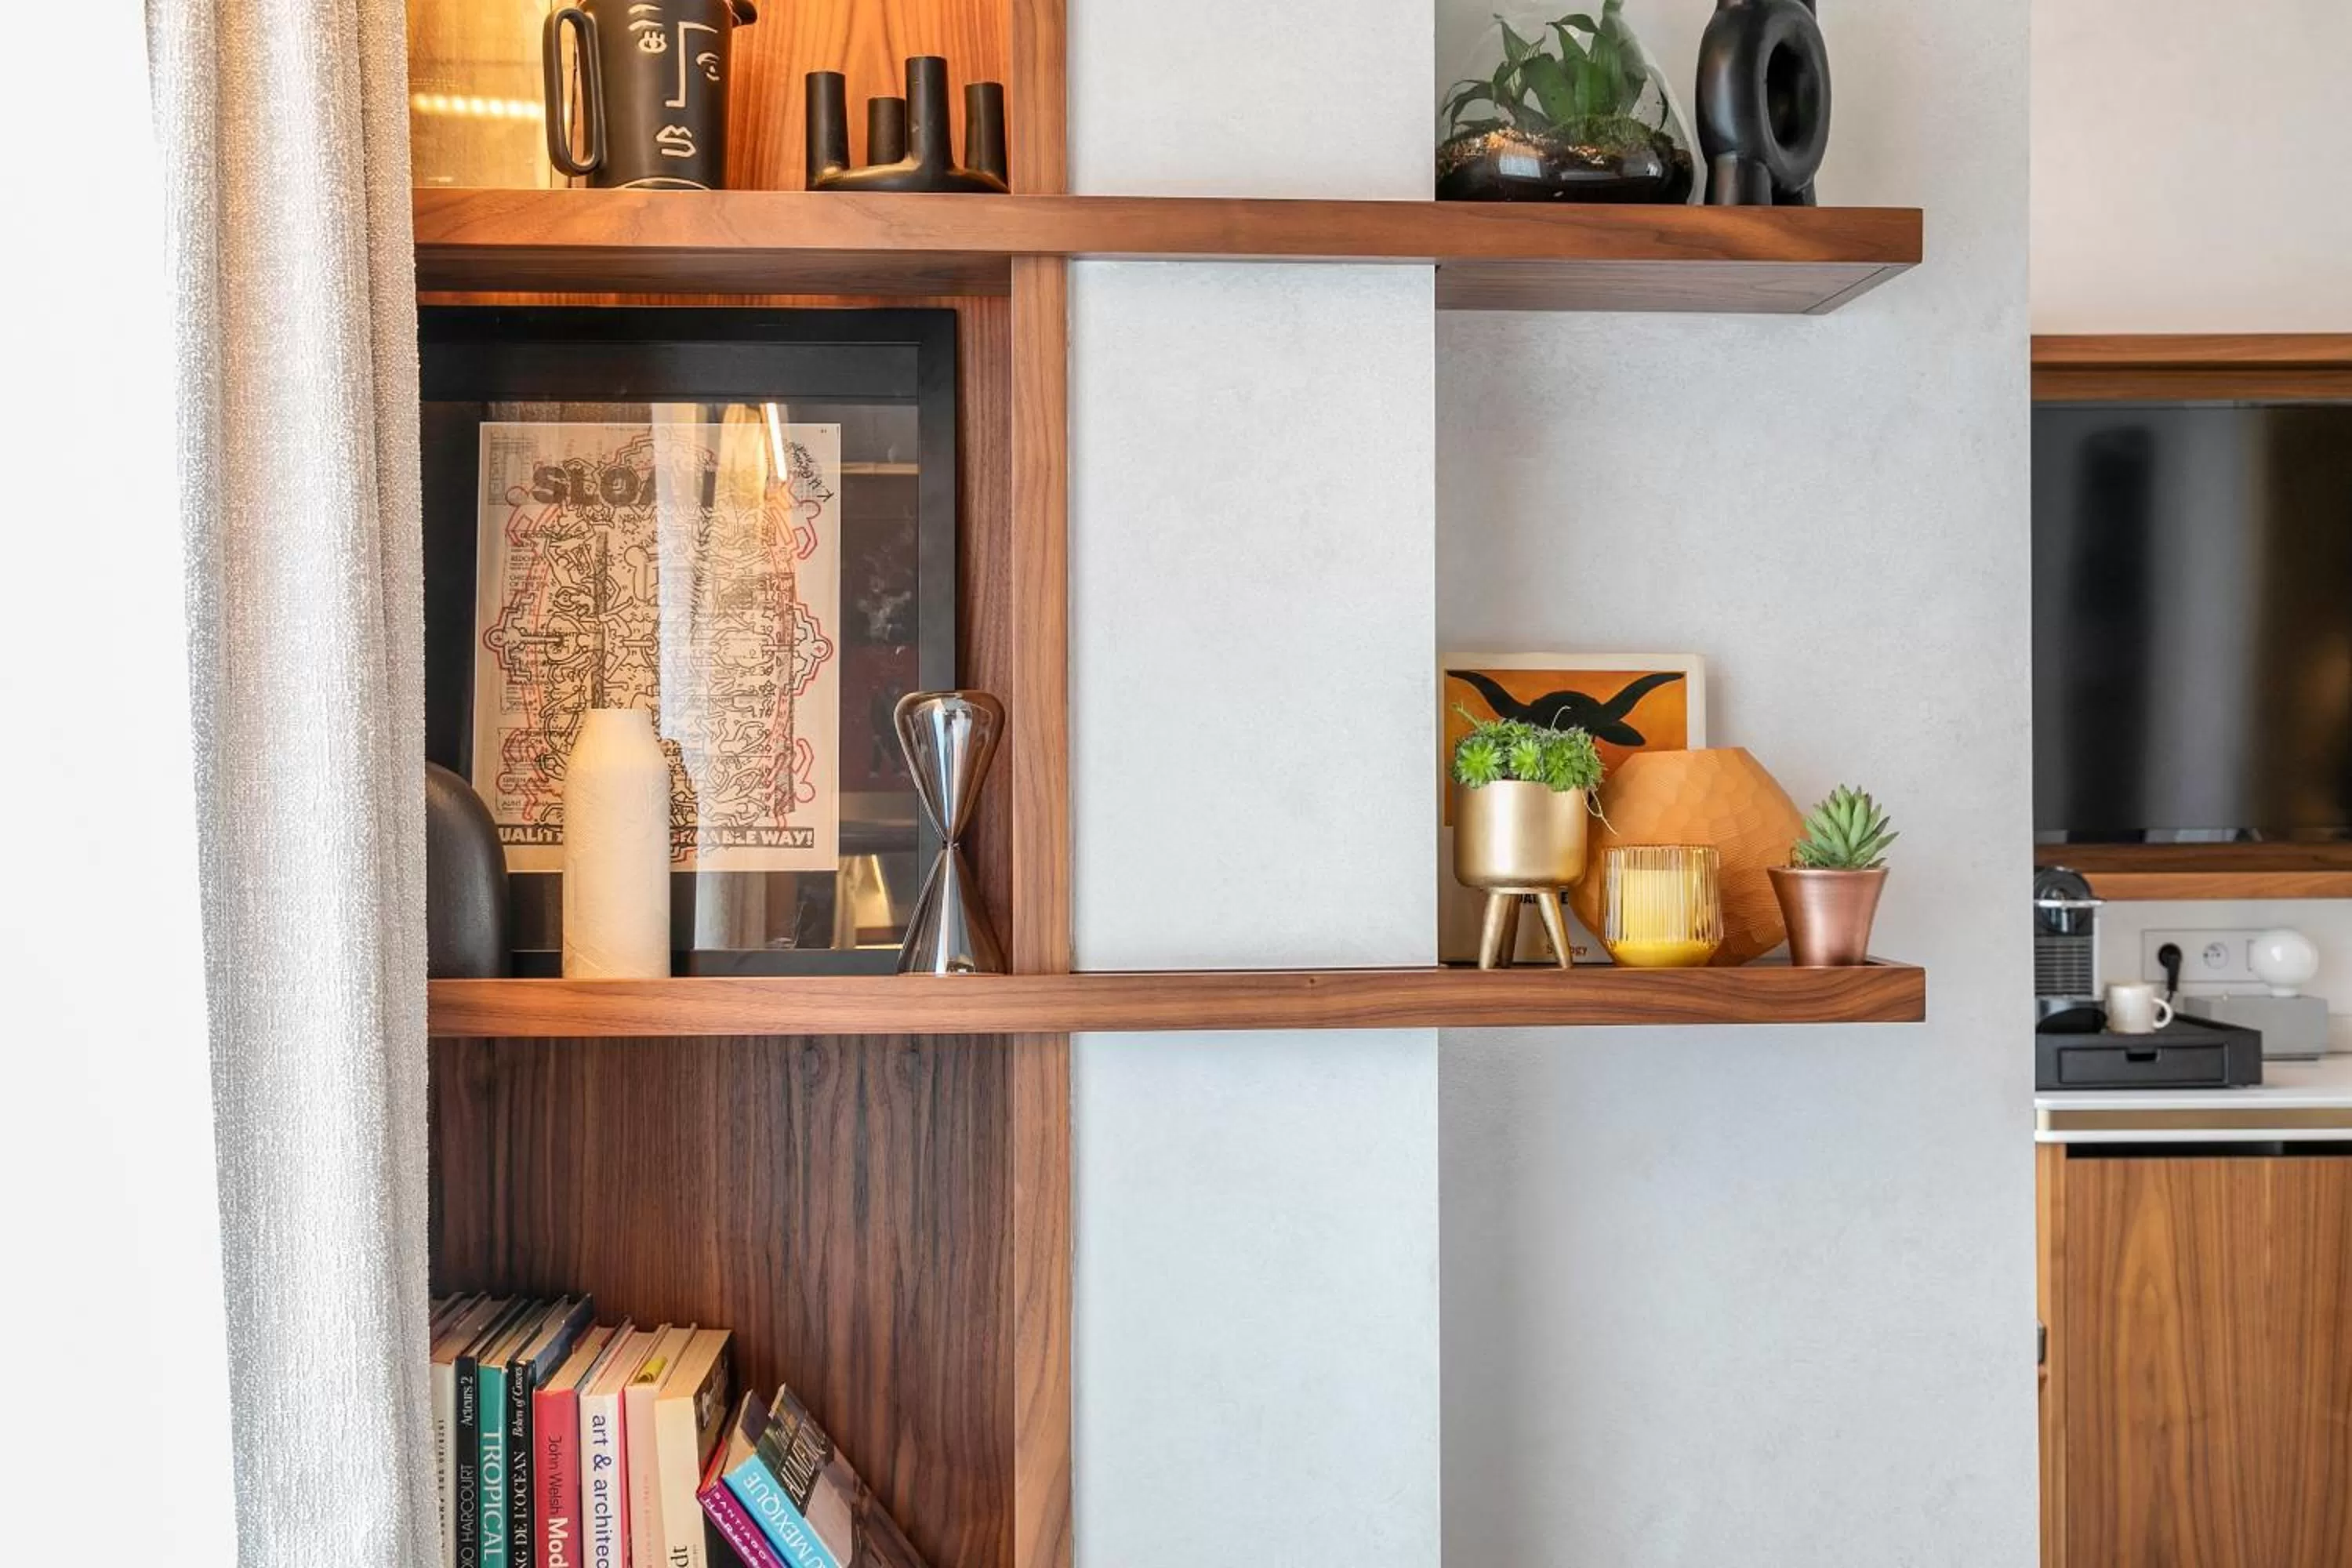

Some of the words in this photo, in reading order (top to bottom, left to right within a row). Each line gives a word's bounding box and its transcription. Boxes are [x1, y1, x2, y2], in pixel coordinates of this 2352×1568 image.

[760, 829, 813, 845] WAY!
[460, 1375, 474, 1385] 2
[592, 1414, 609, 1445] art
[548, 1436, 562, 1471] John
[593, 1454, 612, 1472] &
[460, 1464, 475, 1543] HARCOURT
[483, 1432, 503, 1562] TROPICAL
[548, 1473, 564, 1516] Welsh
[713, 1493, 768, 1560] SANTIAGO
[743, 1472, 814, 1560] MEXIQUE
[514, 1523, 528, 1545] DE
